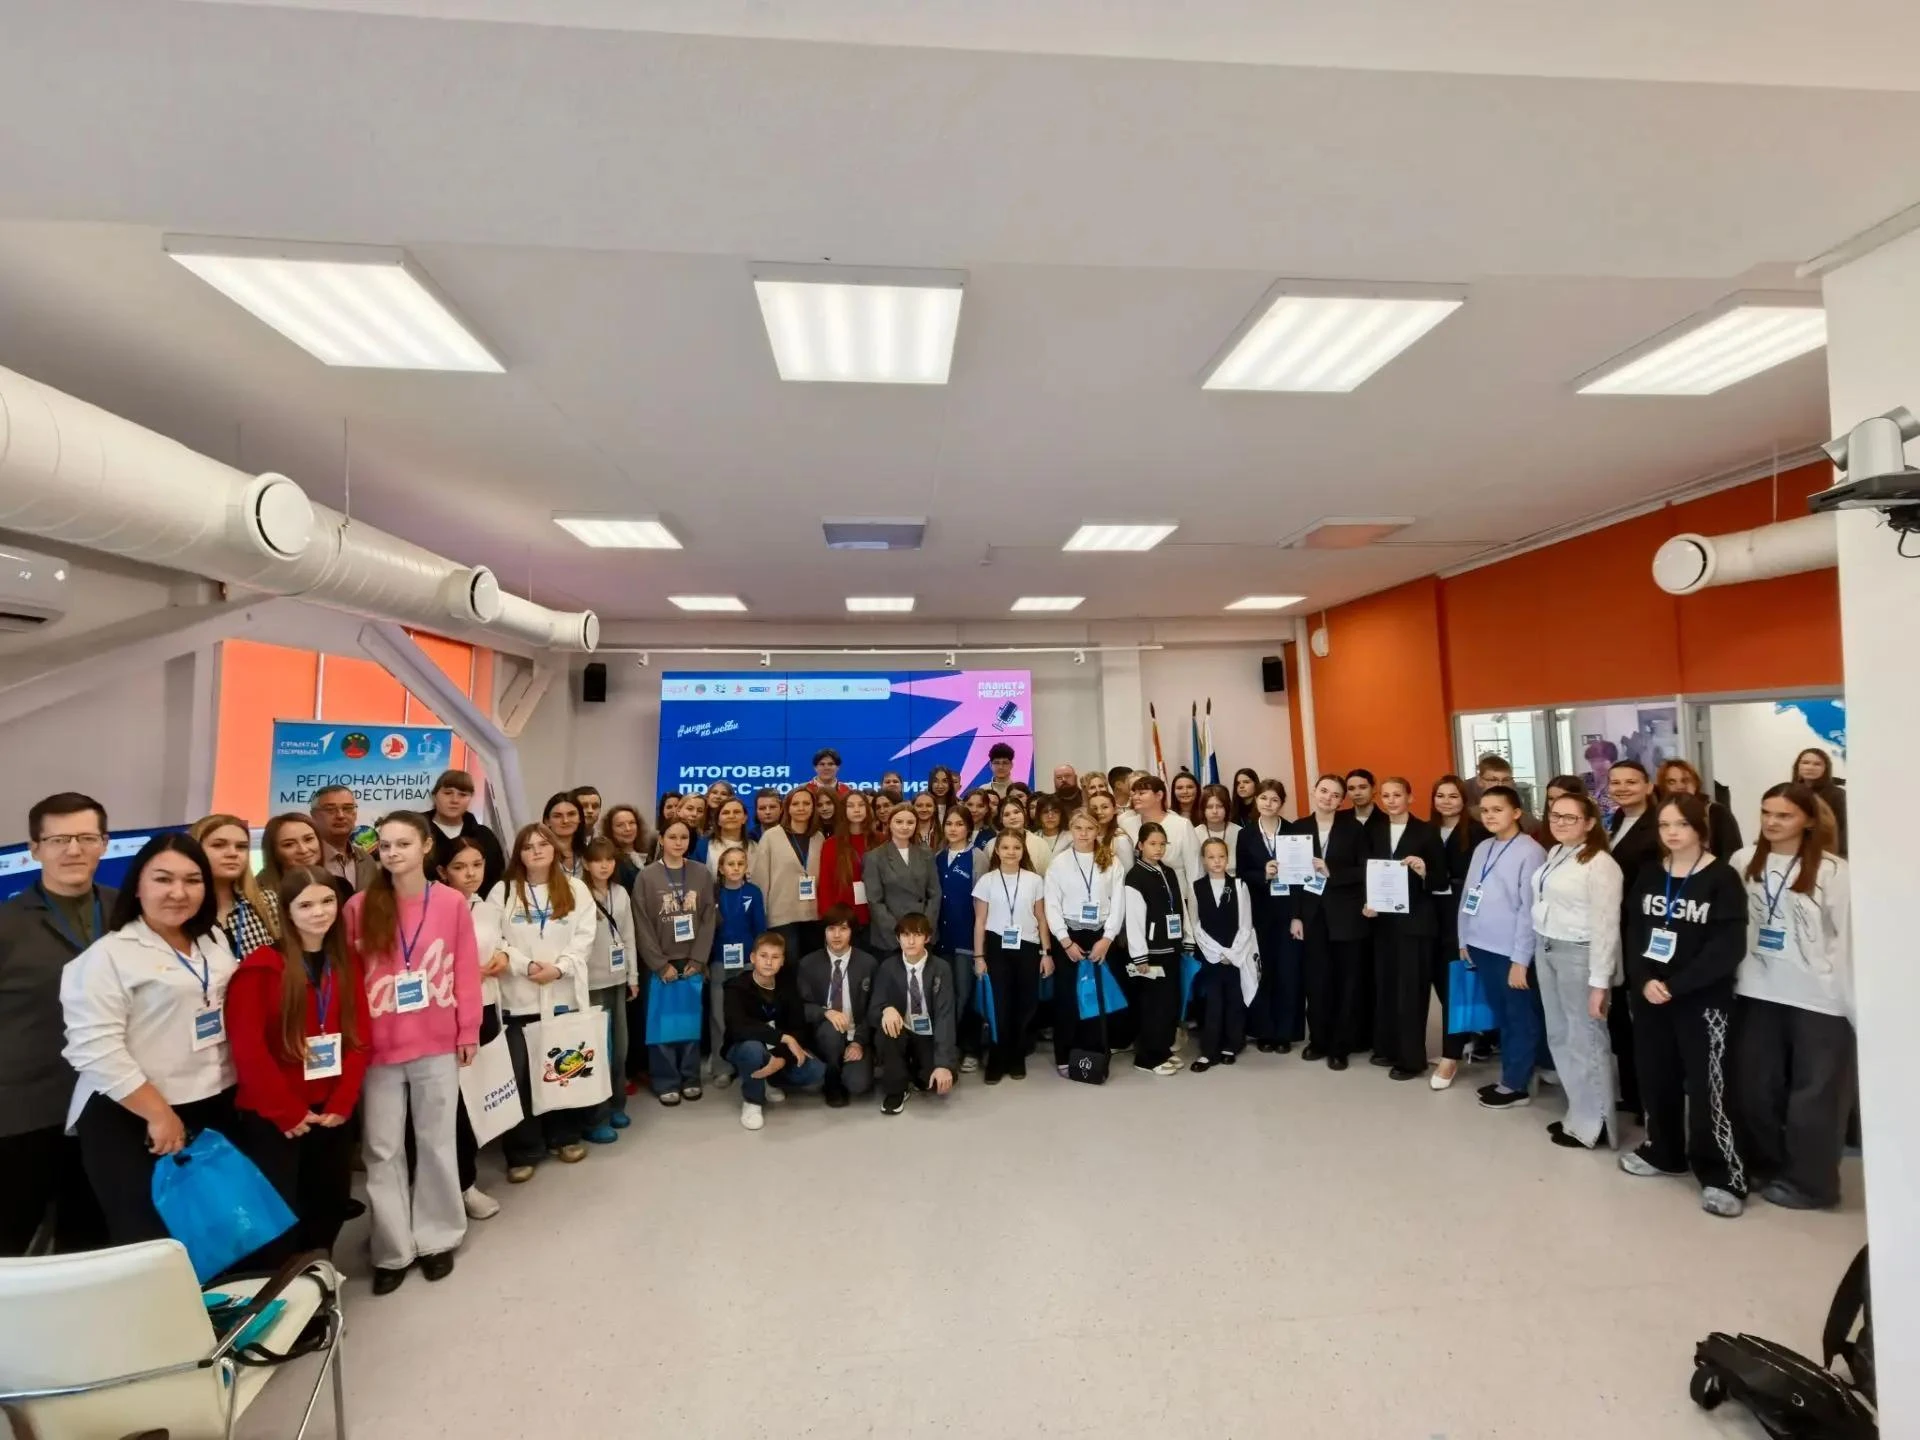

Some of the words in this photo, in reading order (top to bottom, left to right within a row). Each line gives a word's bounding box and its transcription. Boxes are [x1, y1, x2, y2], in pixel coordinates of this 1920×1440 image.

[296, 771, 431, 787] РЕГИОНАЛЬНЫЙ
[679, 765, 791, 778] итоговая
[484, 1077, 517, 1102] ГРАНТ
